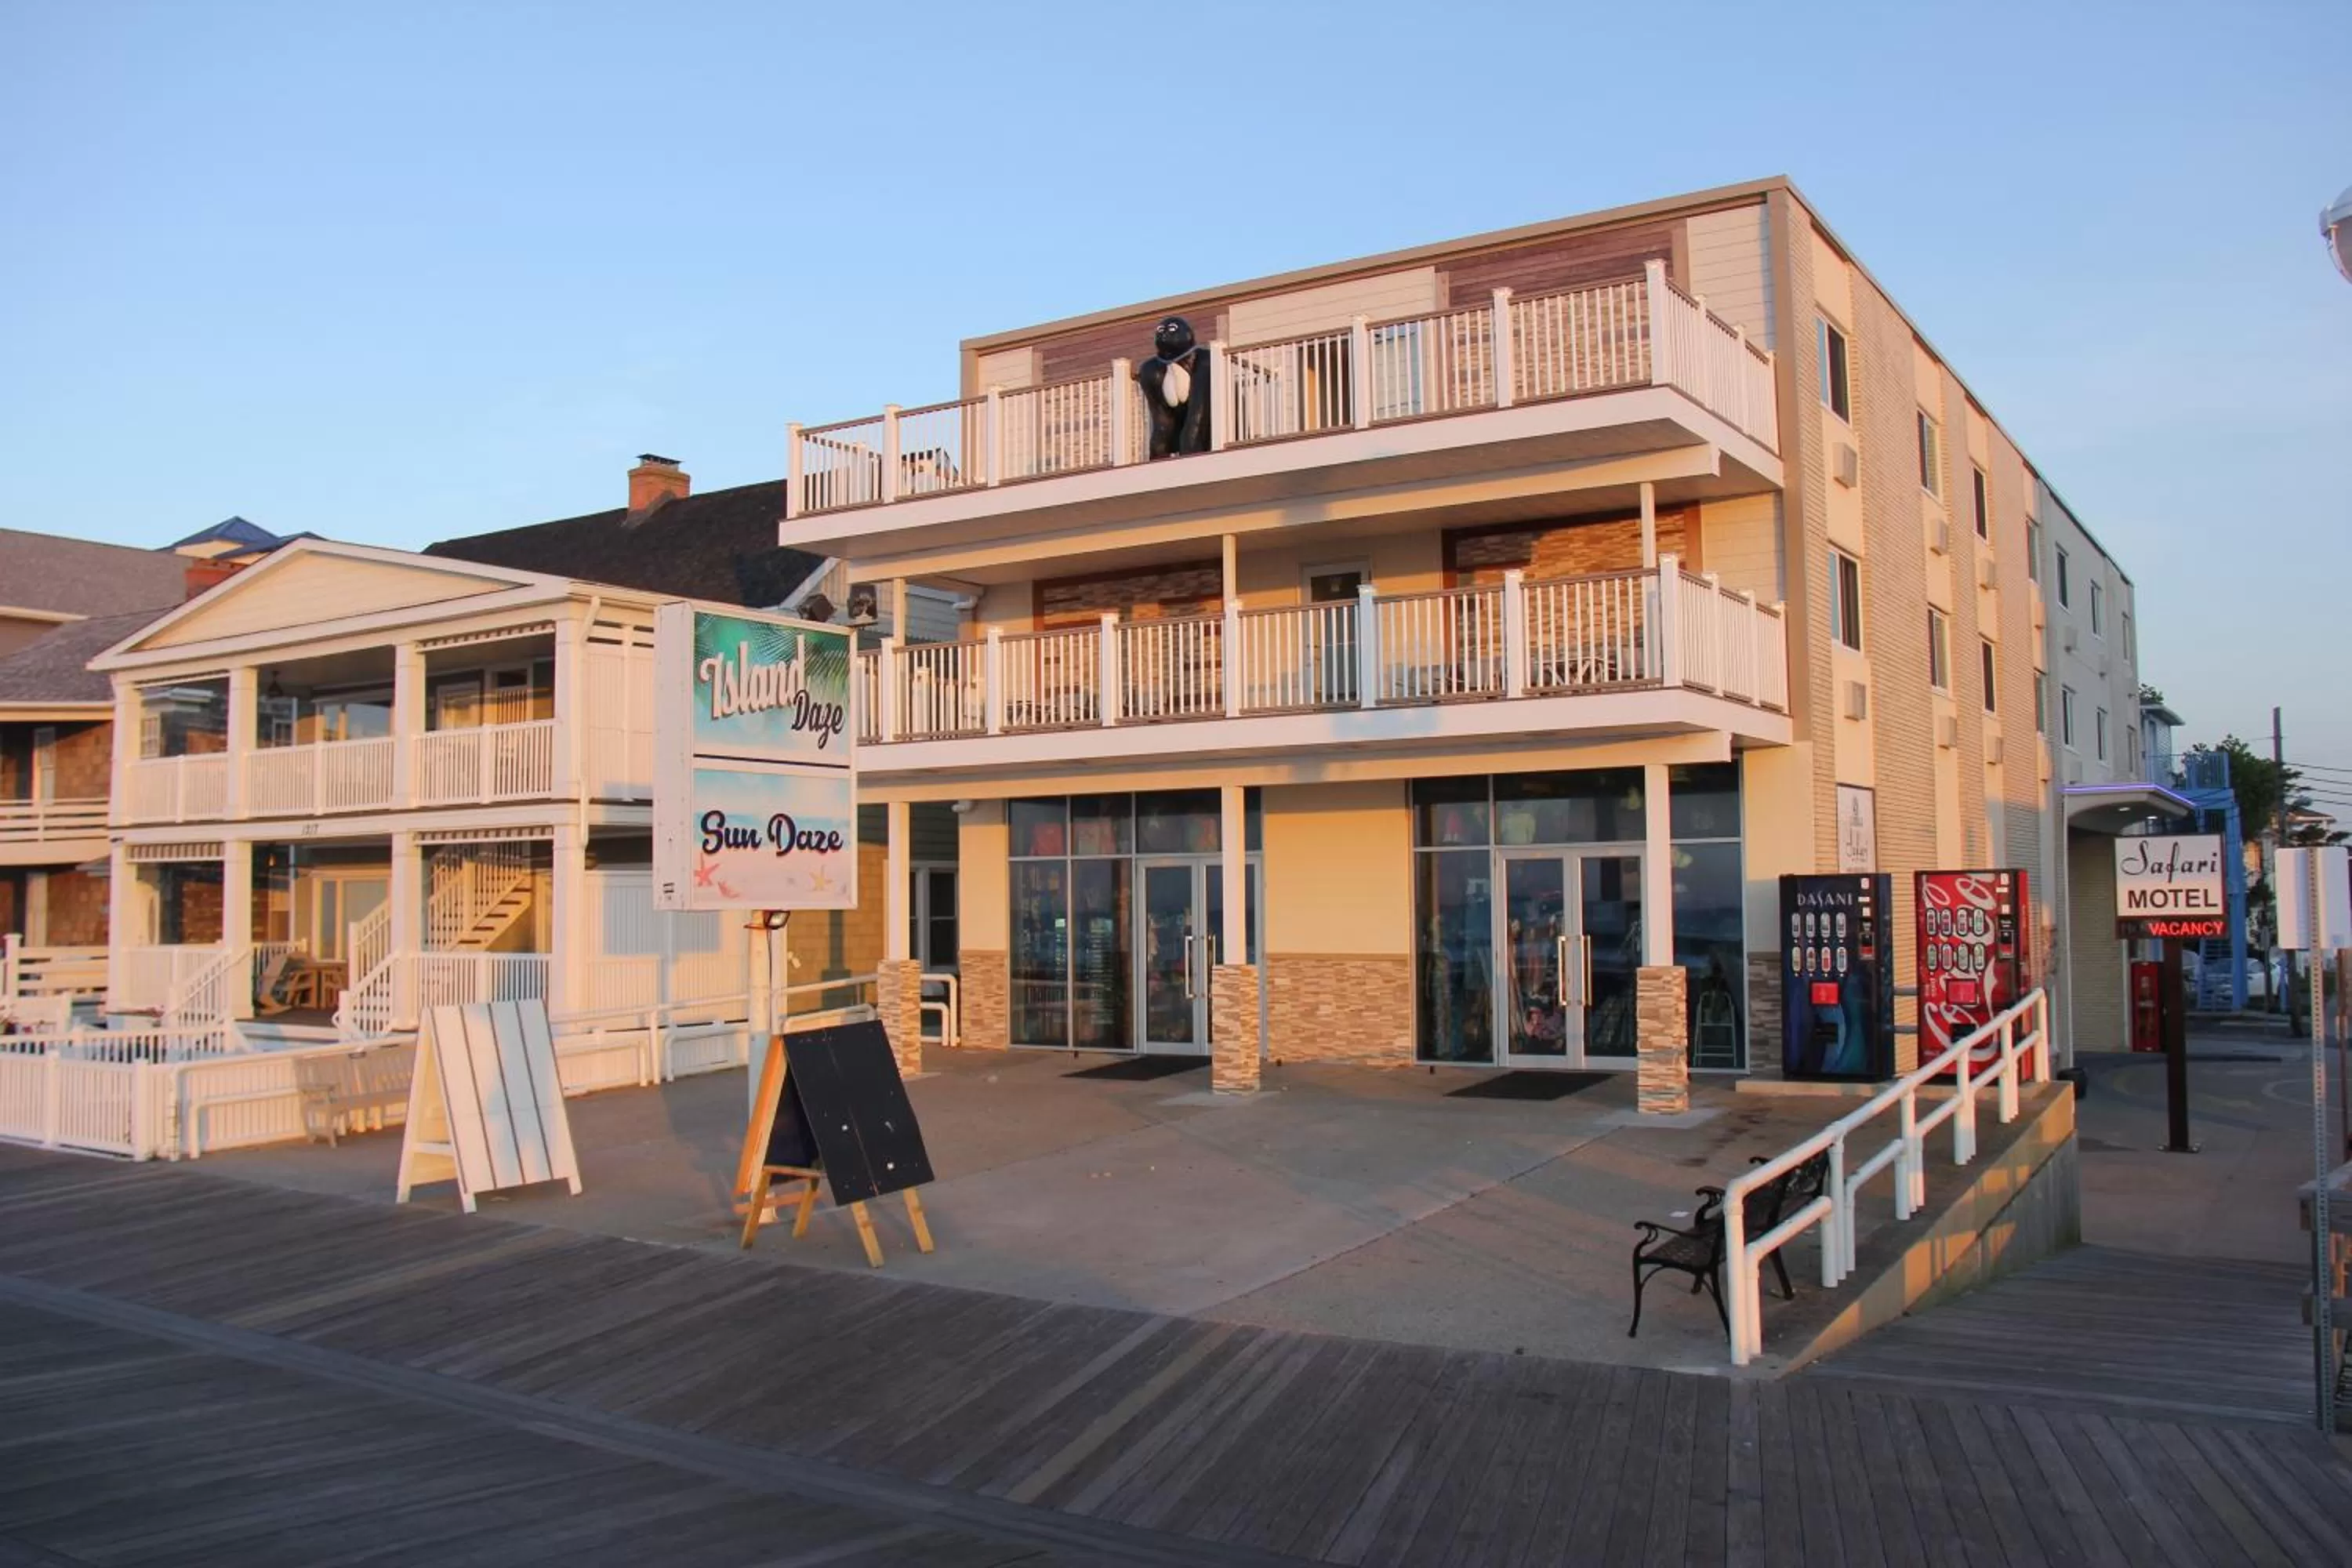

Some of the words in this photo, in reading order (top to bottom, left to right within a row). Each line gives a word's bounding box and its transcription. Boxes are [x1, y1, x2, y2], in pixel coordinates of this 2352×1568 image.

[699, 634, 808, 720] Island
[791, 688, 844, 750] Daze
[700, 810, 761, 855] Sun
[768, 813, 844, 857] Daze
[2120, 840, 2218, 884] Safari
[1796, 891, 1853, 907] DASANI
[2127, 889, 2220, 909] MOTEL
[2148, 921, 2224, 936] VACANCY
